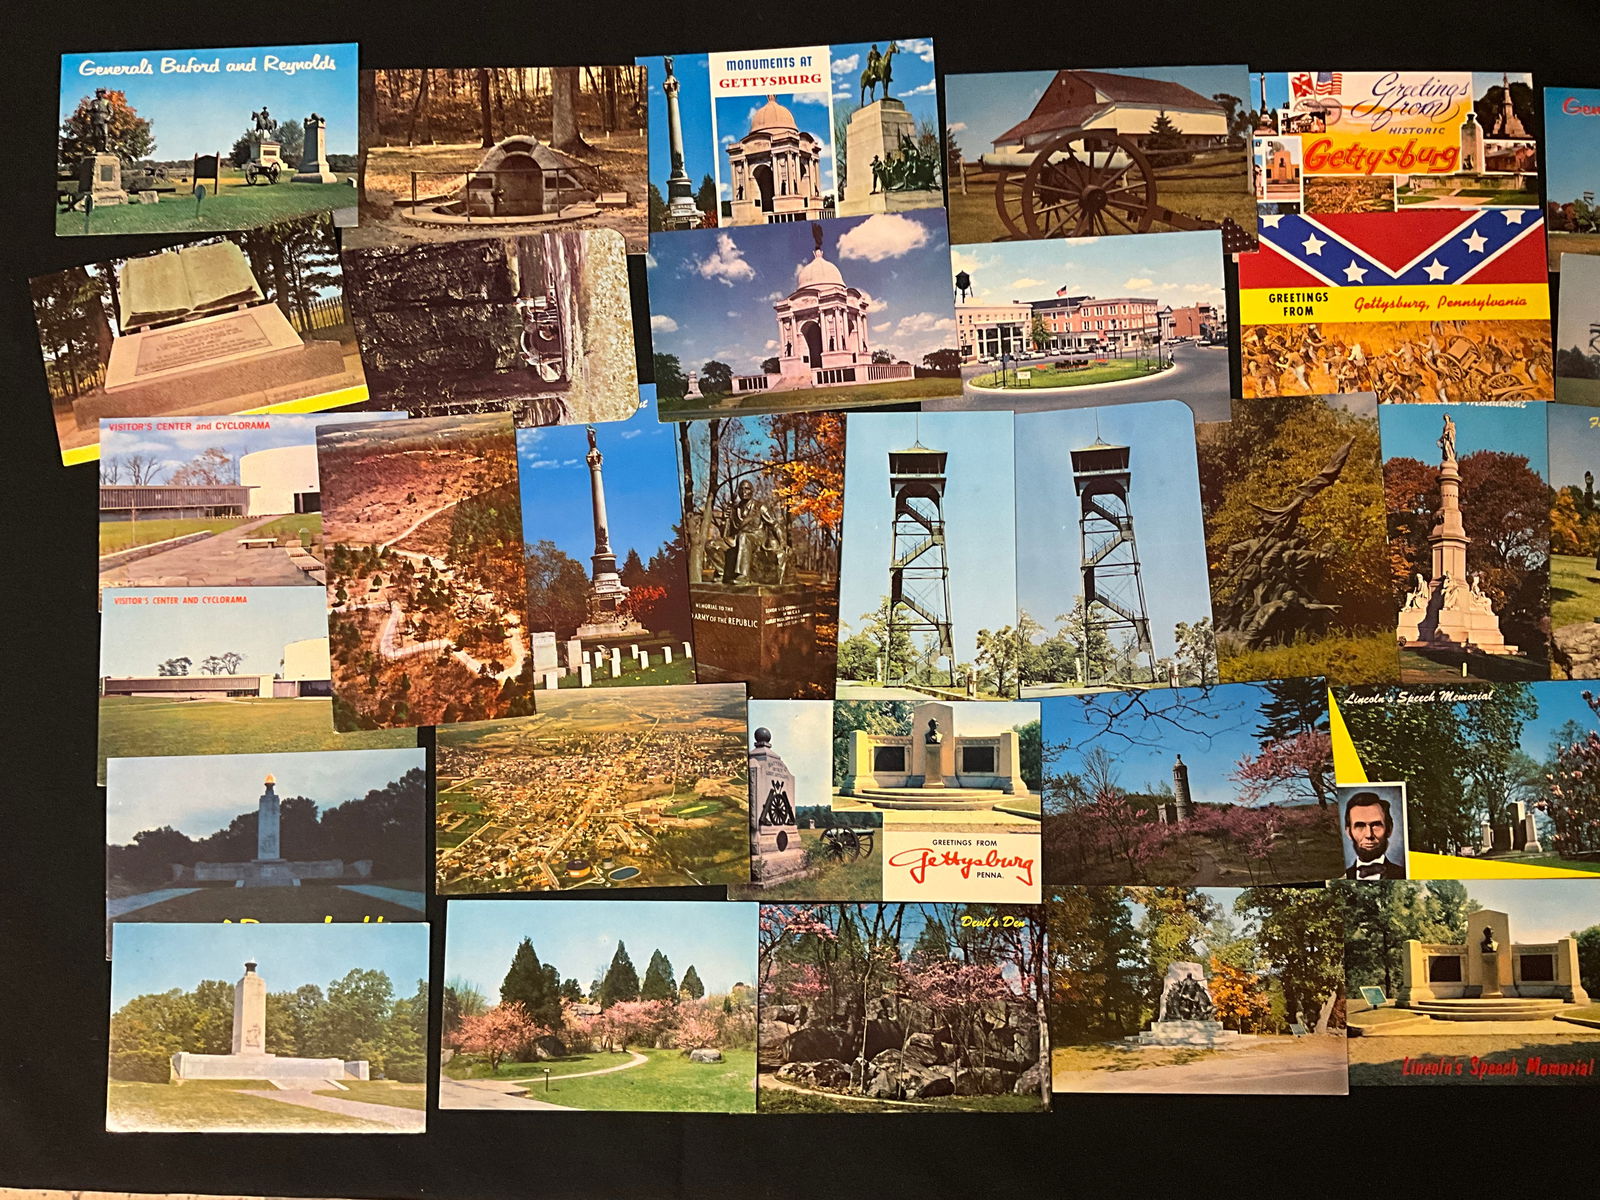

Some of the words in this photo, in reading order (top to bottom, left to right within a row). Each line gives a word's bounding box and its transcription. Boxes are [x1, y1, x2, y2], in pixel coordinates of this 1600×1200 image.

[78, 58, 153, 76] Generals
[160, 56, 220, 74] Buford
[226, 57, 256, 73] and
[263, 53, 337, 75] Reynolds
[726, 57, 795, 71] MONUMENTS
[800, 56, 812, 67] AT
[719, 73, 822, 89] GETTYSBURG
[1351, 72, 1470, 118] Greetings
[1371, 93, 1460, 132] from
[1388, 127, 1446, 135] HISTORIC
[1303, 137, 1461, 175] Gettysburg
[1269, 292, 1329, 303] GREETINGS
[1354, 296, 1430, 313] Gettysburg,
[1437, 294, 1527, 311] Pennsylvania
[1283, 306, 1314, 317] FROM
[109, 423, 153, 431] VISITOR'S
[156, 422, 192, 431] CENTER
[196, 422, 212, 430] and
[215, 421, 271, 430] CYCLORAMA
[114, 596, 149, 605] VISITOR'S
[152, 596, 178, 604] CENTER
[182, 596, 199, 604] AND
[202, 595, 248, 604] CYCLORAMA
[694, 613, 710, 621] ARMY
[728, 617, 758, 628] REPUBLIC
[1344, 691, 1393, 705] Lincoln's
[1397, 690, 1435, 705] Speech
[1438, 689, 1494, 702] Memorial
[888, 848, 1034, 886] Gettysburg
[976, 871, 1005, 879] PENNA.
[960, 915, 999, 928] Devil's
[1002, 915, 1026, 928] Den
[1402, 1056, 1463, 1076] Lincoln's
[1469, 1056, 1518, 1080] Speech
[1526, 1056, 1595, 1076] Memorial
